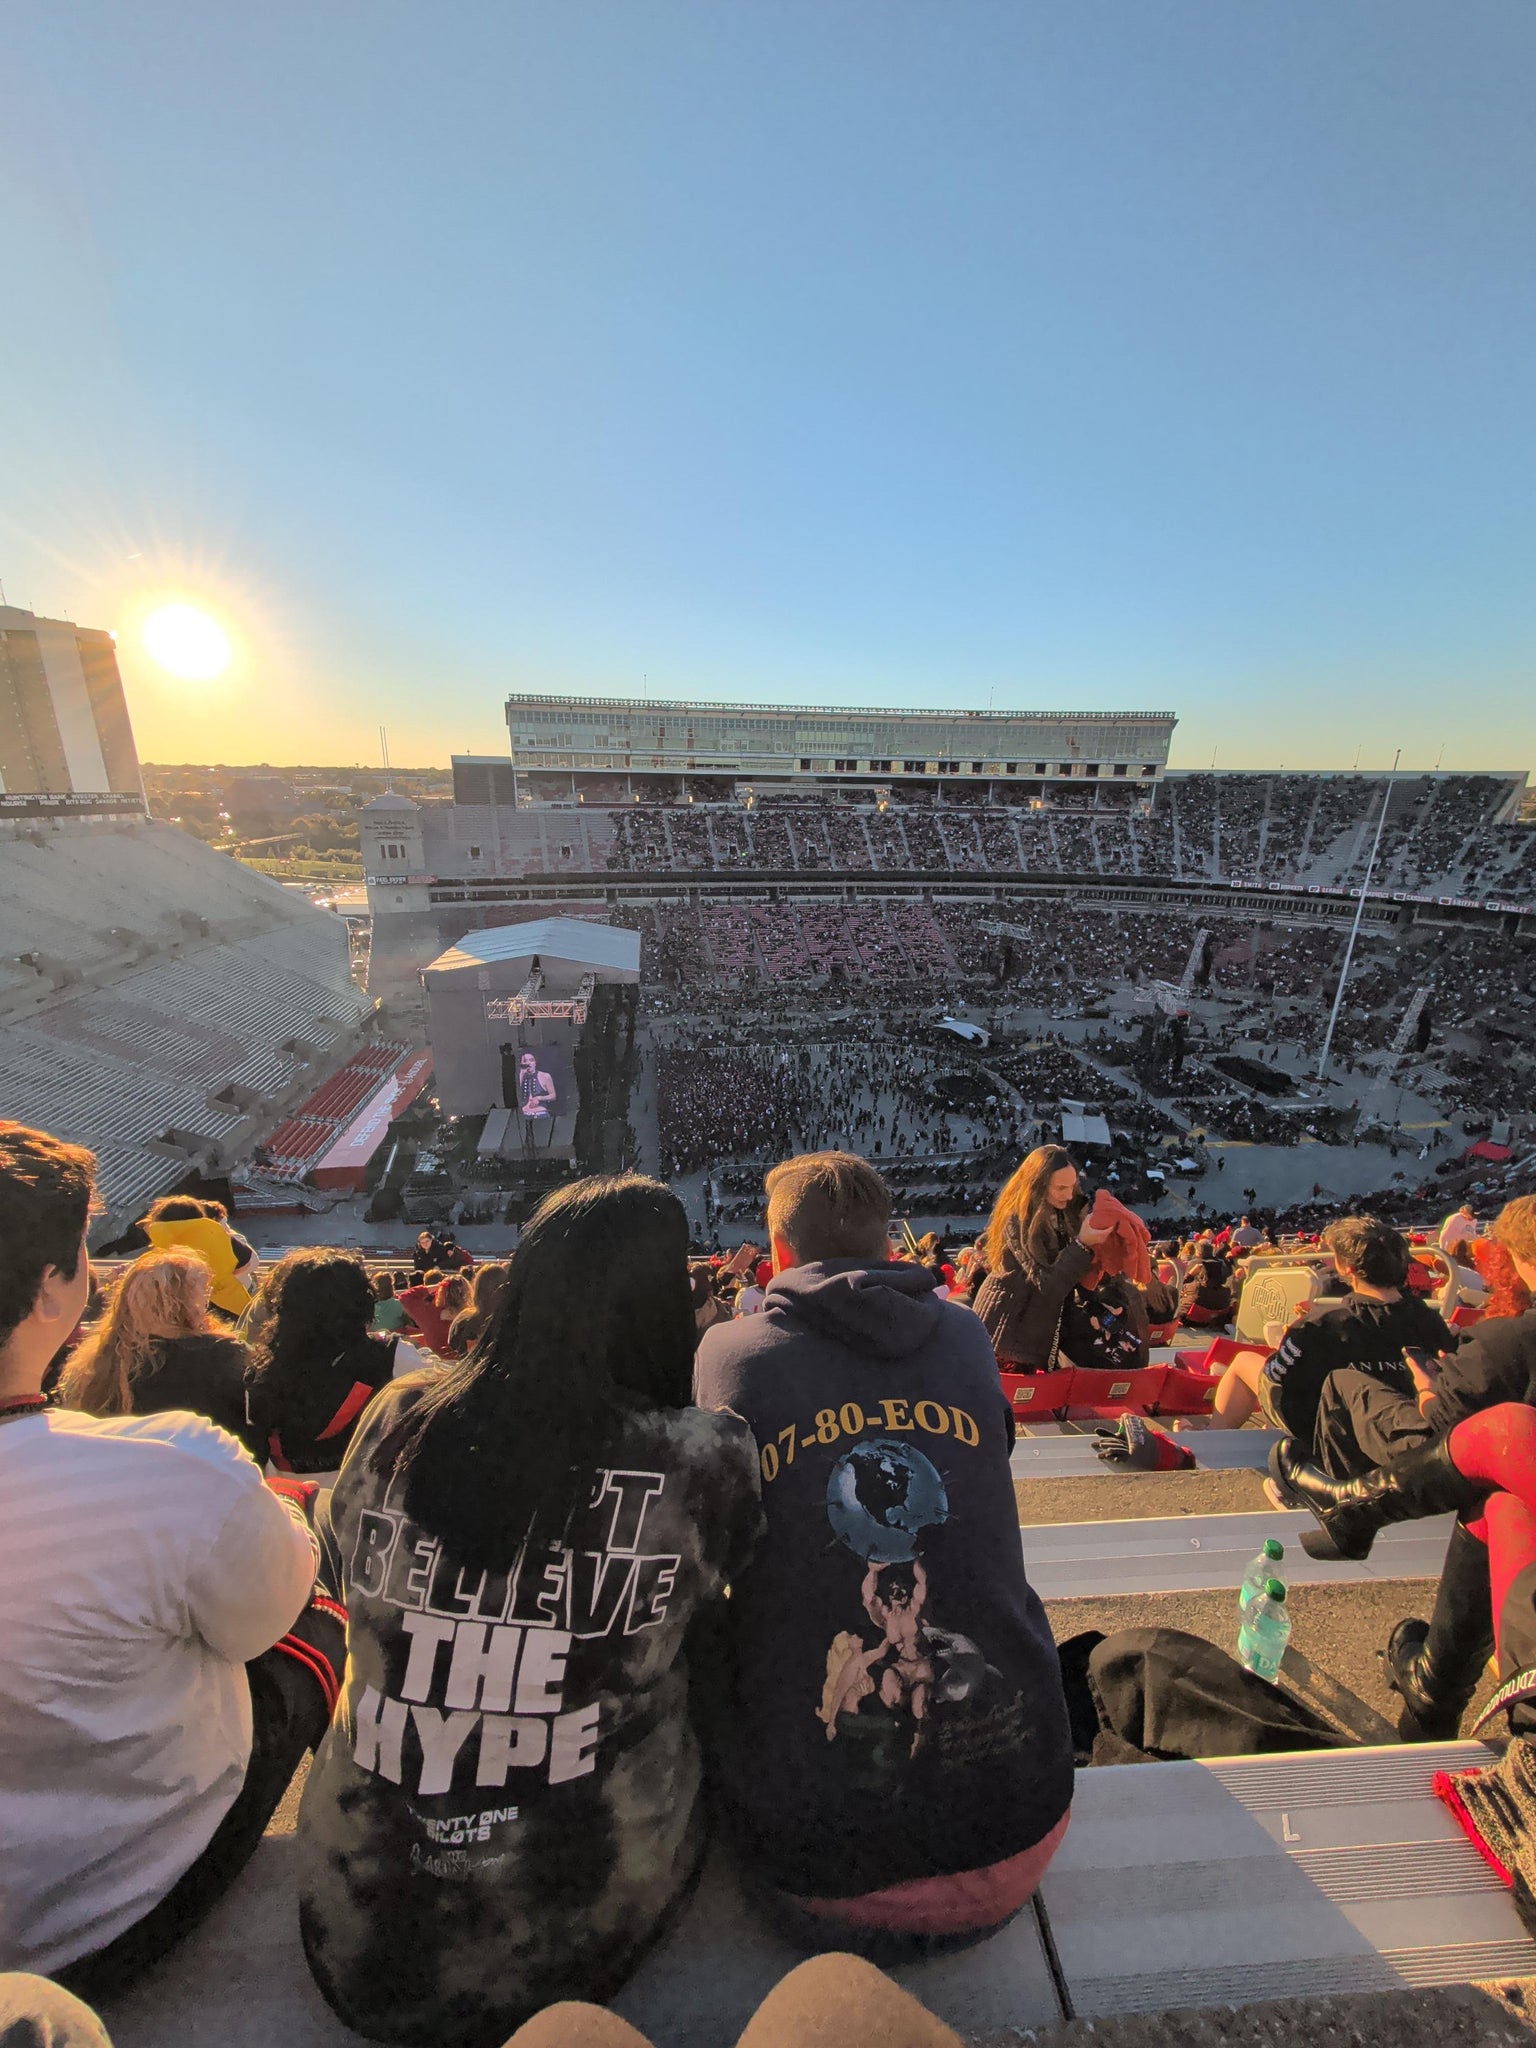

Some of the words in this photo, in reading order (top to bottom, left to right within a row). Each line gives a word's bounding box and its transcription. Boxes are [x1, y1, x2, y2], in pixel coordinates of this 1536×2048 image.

[1347, 1361, 1372, 1371] AN
[761, 1399, 980, 1483] 07-80-EOD
[350, 1508, 682, 1639] BELIEVE
[400, 1611, 573, 1714] THE
[352, 1684, 600, 1795] HYPE
[1282, 1813, 1302, 1842] L
